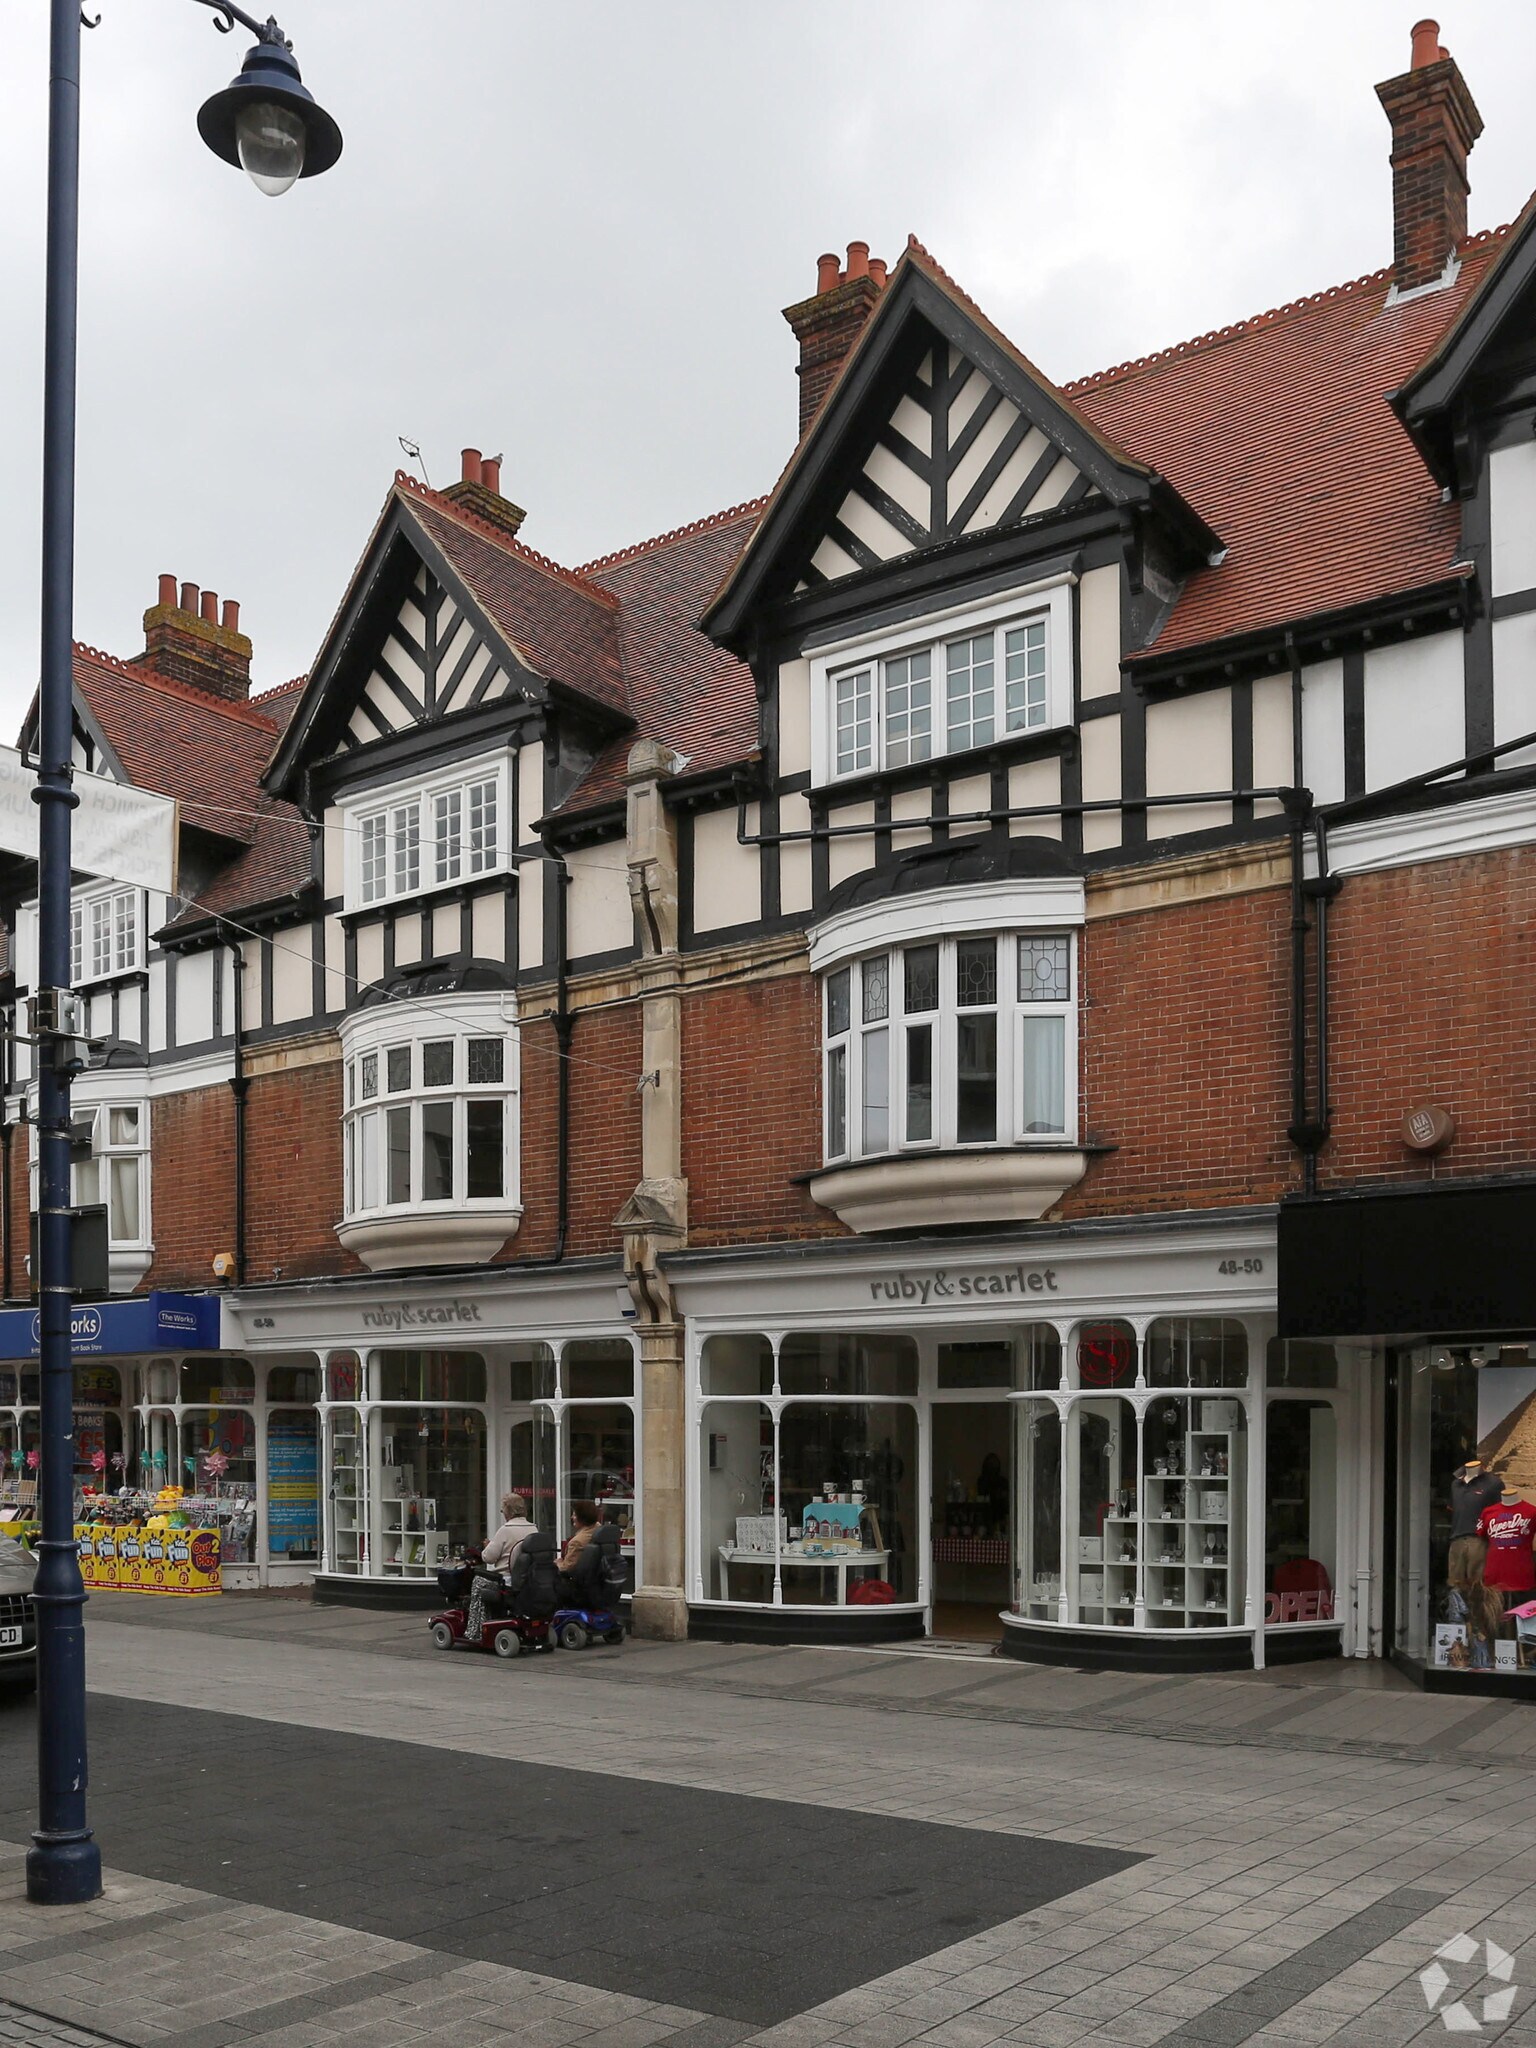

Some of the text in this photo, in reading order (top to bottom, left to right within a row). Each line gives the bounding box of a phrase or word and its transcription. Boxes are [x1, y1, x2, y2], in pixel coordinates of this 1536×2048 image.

[1218, 1258, 1263, 1275] 48-50
[870, 1266, 1058, 1304] ruby&scarlet
[71, 1314, 97, 1334] orks
[161, 1313, 194, 1324] The Works
[362, 1301, 482, 1330] ruby&scarlet
[167, 1544, 189, 1562] Fun
[192, 1539, 220, 1554] Out 2
[196, 1554, 217, 1569] Play
[1264, 1590, 1335, 1625] OPEN
